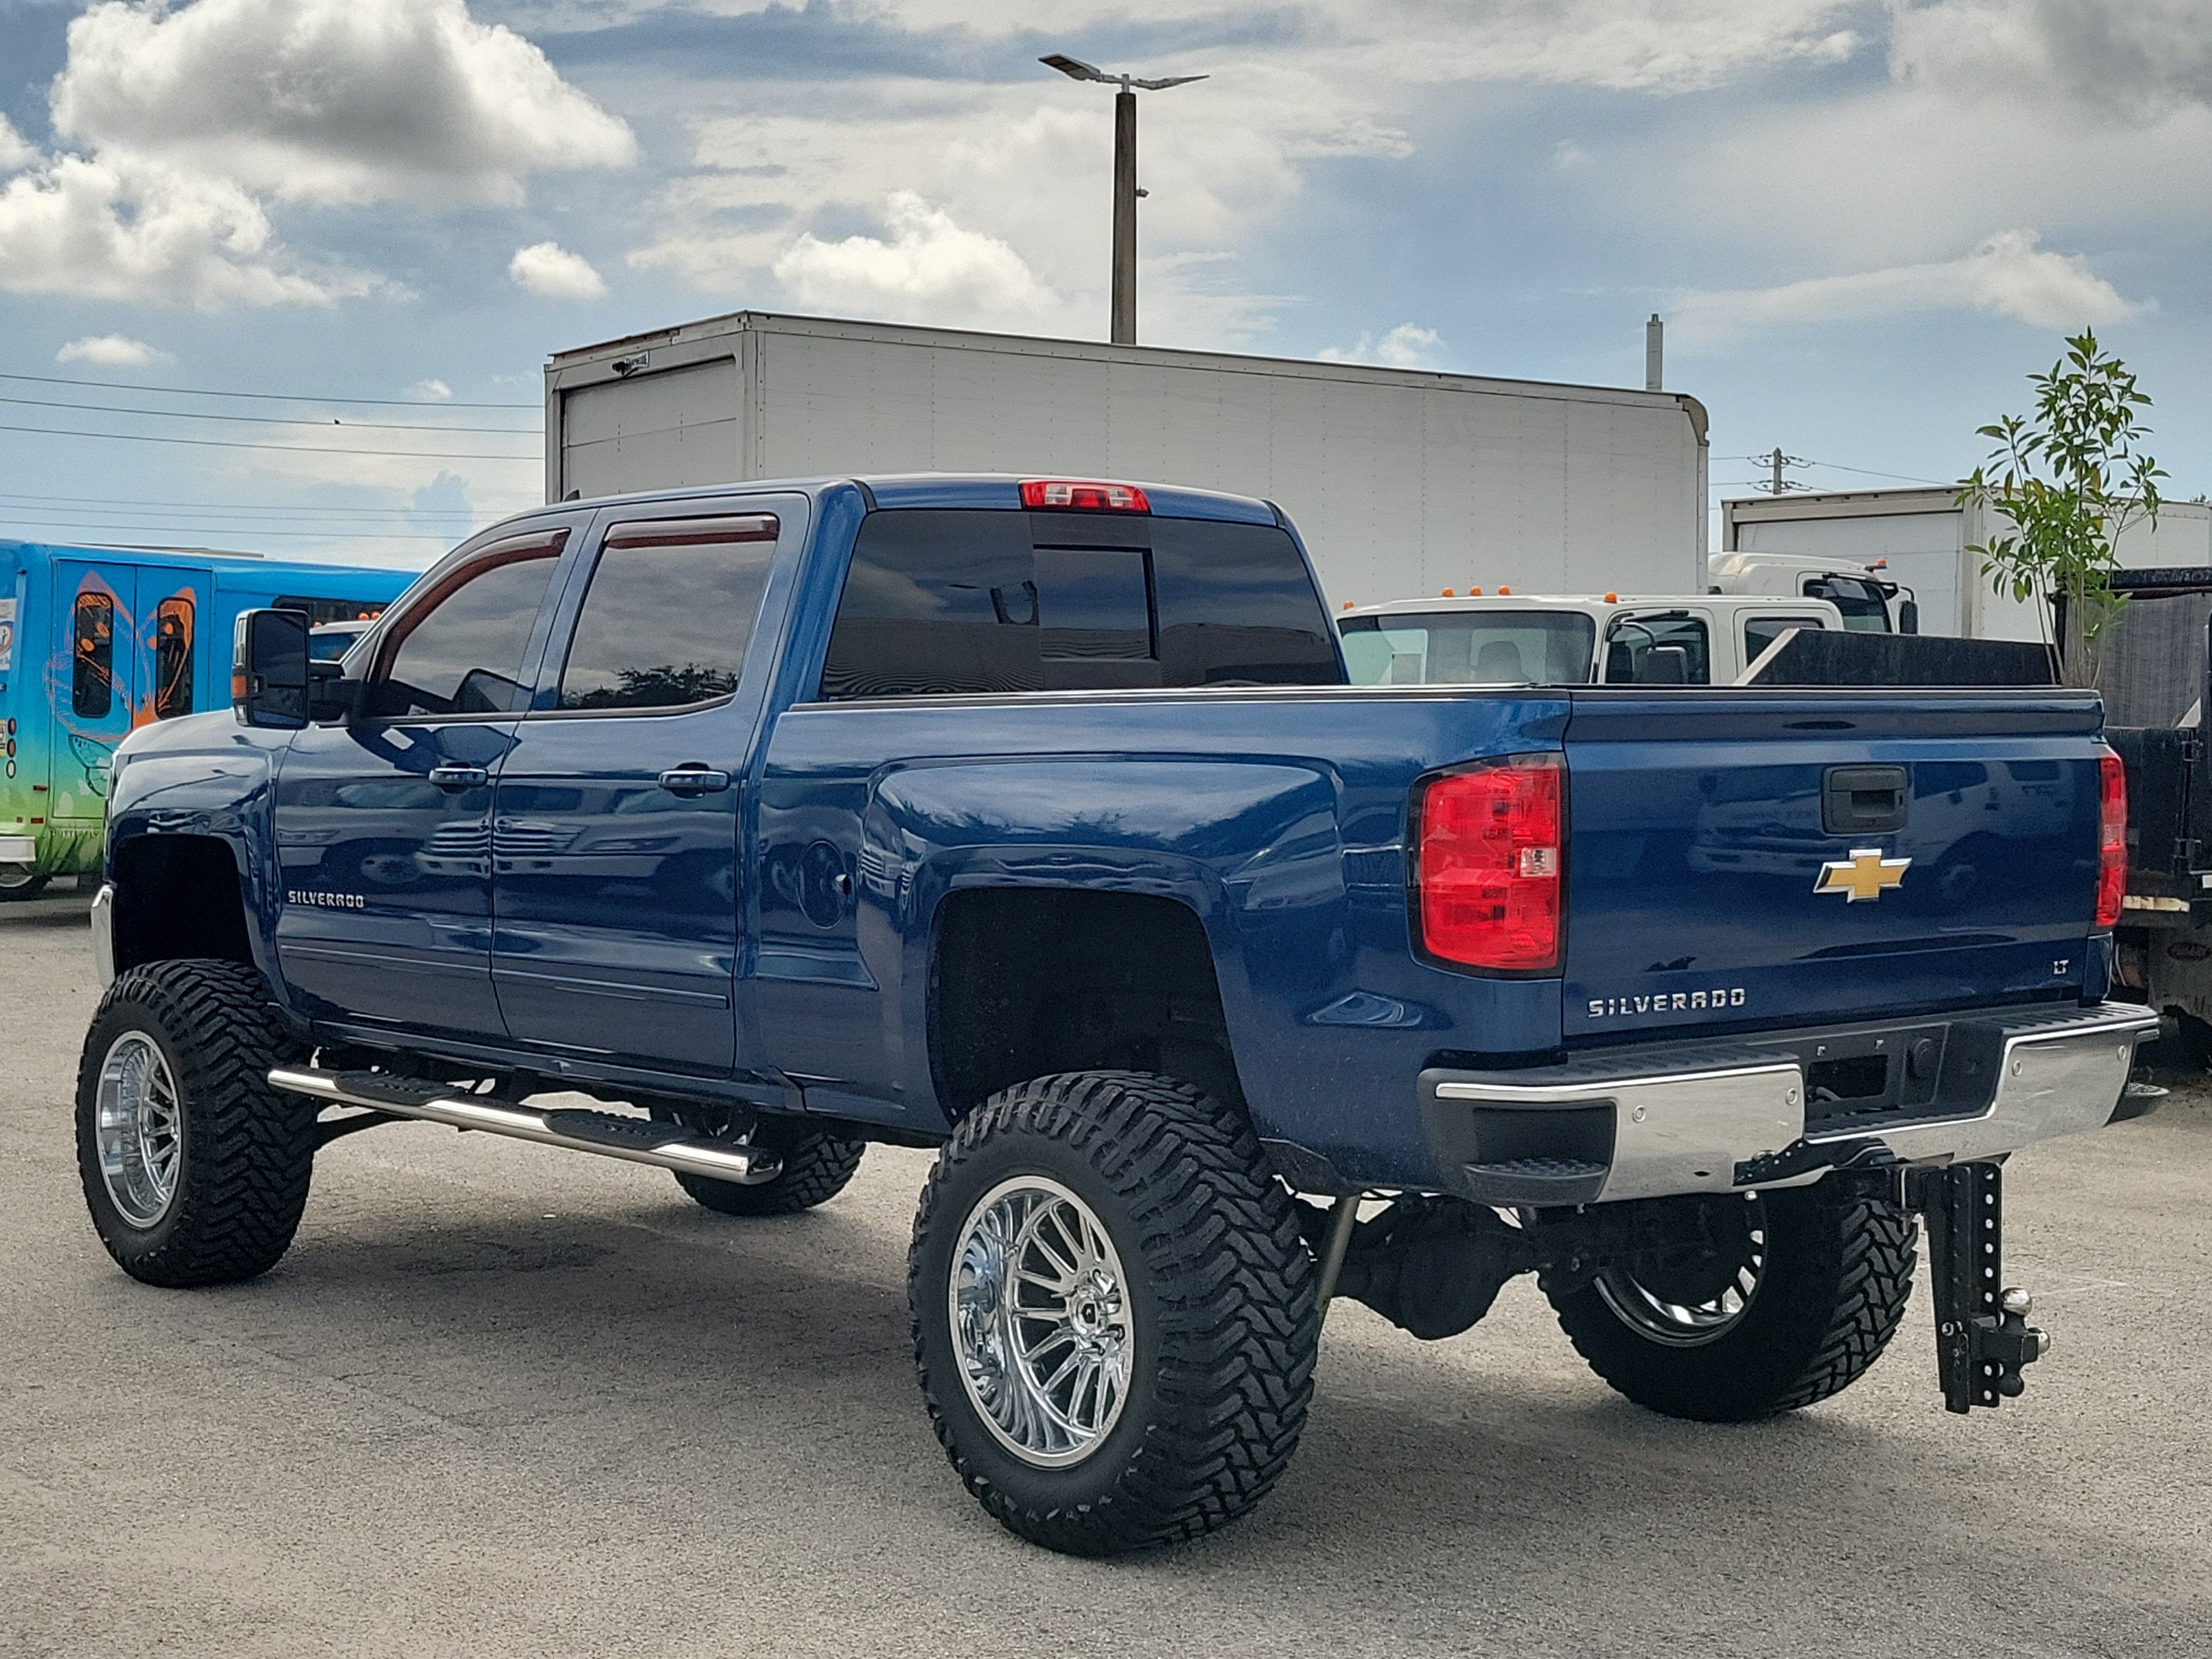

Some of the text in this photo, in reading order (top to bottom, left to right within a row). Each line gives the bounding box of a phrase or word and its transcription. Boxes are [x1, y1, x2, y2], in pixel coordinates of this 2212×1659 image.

[288, 890, 364, 908] SILVERADO
[2053, 959, 2069, 974] LT
[1588, 988, 1745, 1018] SILVERADO
